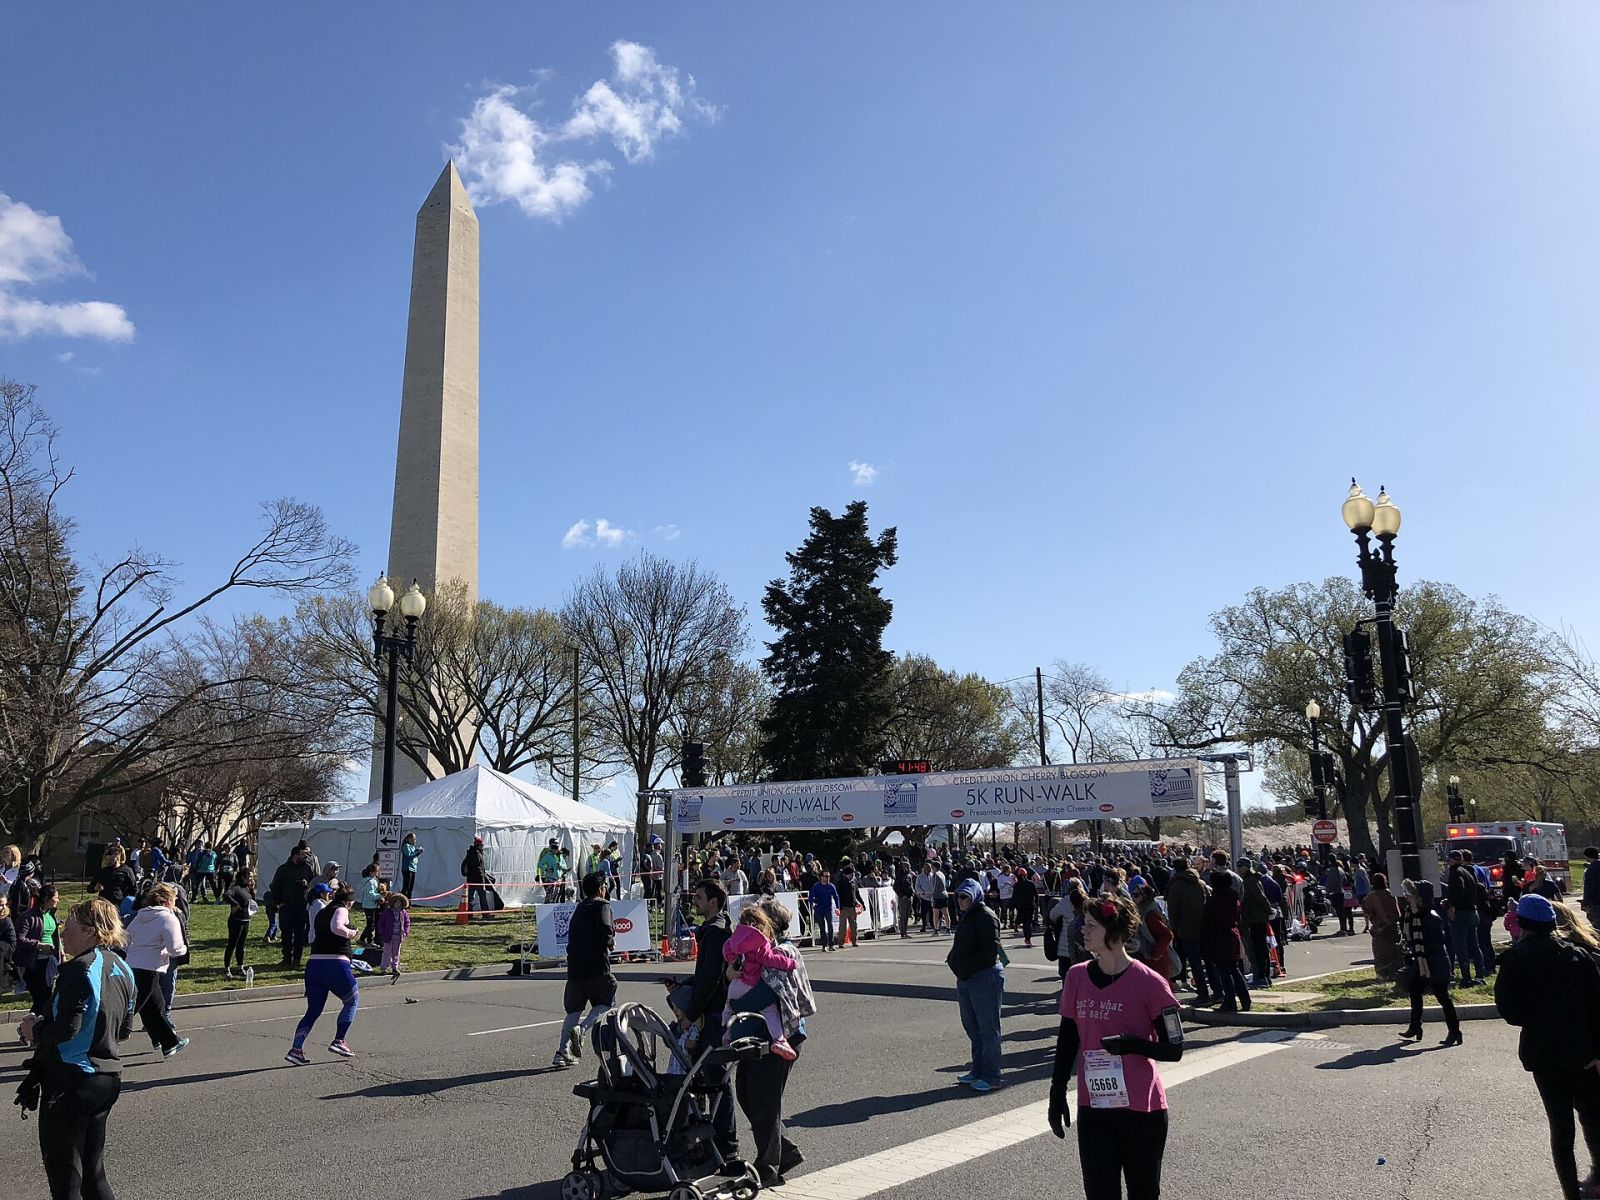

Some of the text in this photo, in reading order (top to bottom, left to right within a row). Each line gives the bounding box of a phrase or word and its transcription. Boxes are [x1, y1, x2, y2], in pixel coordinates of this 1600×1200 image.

[953, 769, 1108, 786] CREDIT UNION CHERRY BLOSSOM
[731, 783, 853, 798] CREDIT UNION CHERRY BLOSSOM
[966, 782, 1097, 806] 5K RUN-WALK
[739, 795, 841, 816] 5K RUN-WALK
[969, 804, 1094, 817] Presented by Hood Cottage Cheese
[380, 817, 399, 826] ONE
[738, 813, 838, 825] Presented by Hood Cottage Cheese
[379, 827, 400, 836] WAY
[1099, 999, 1124, 1012] what
[1089, 1009, 1110, 1020] said.
[1089, 1077, 1119, 1091] 25668
